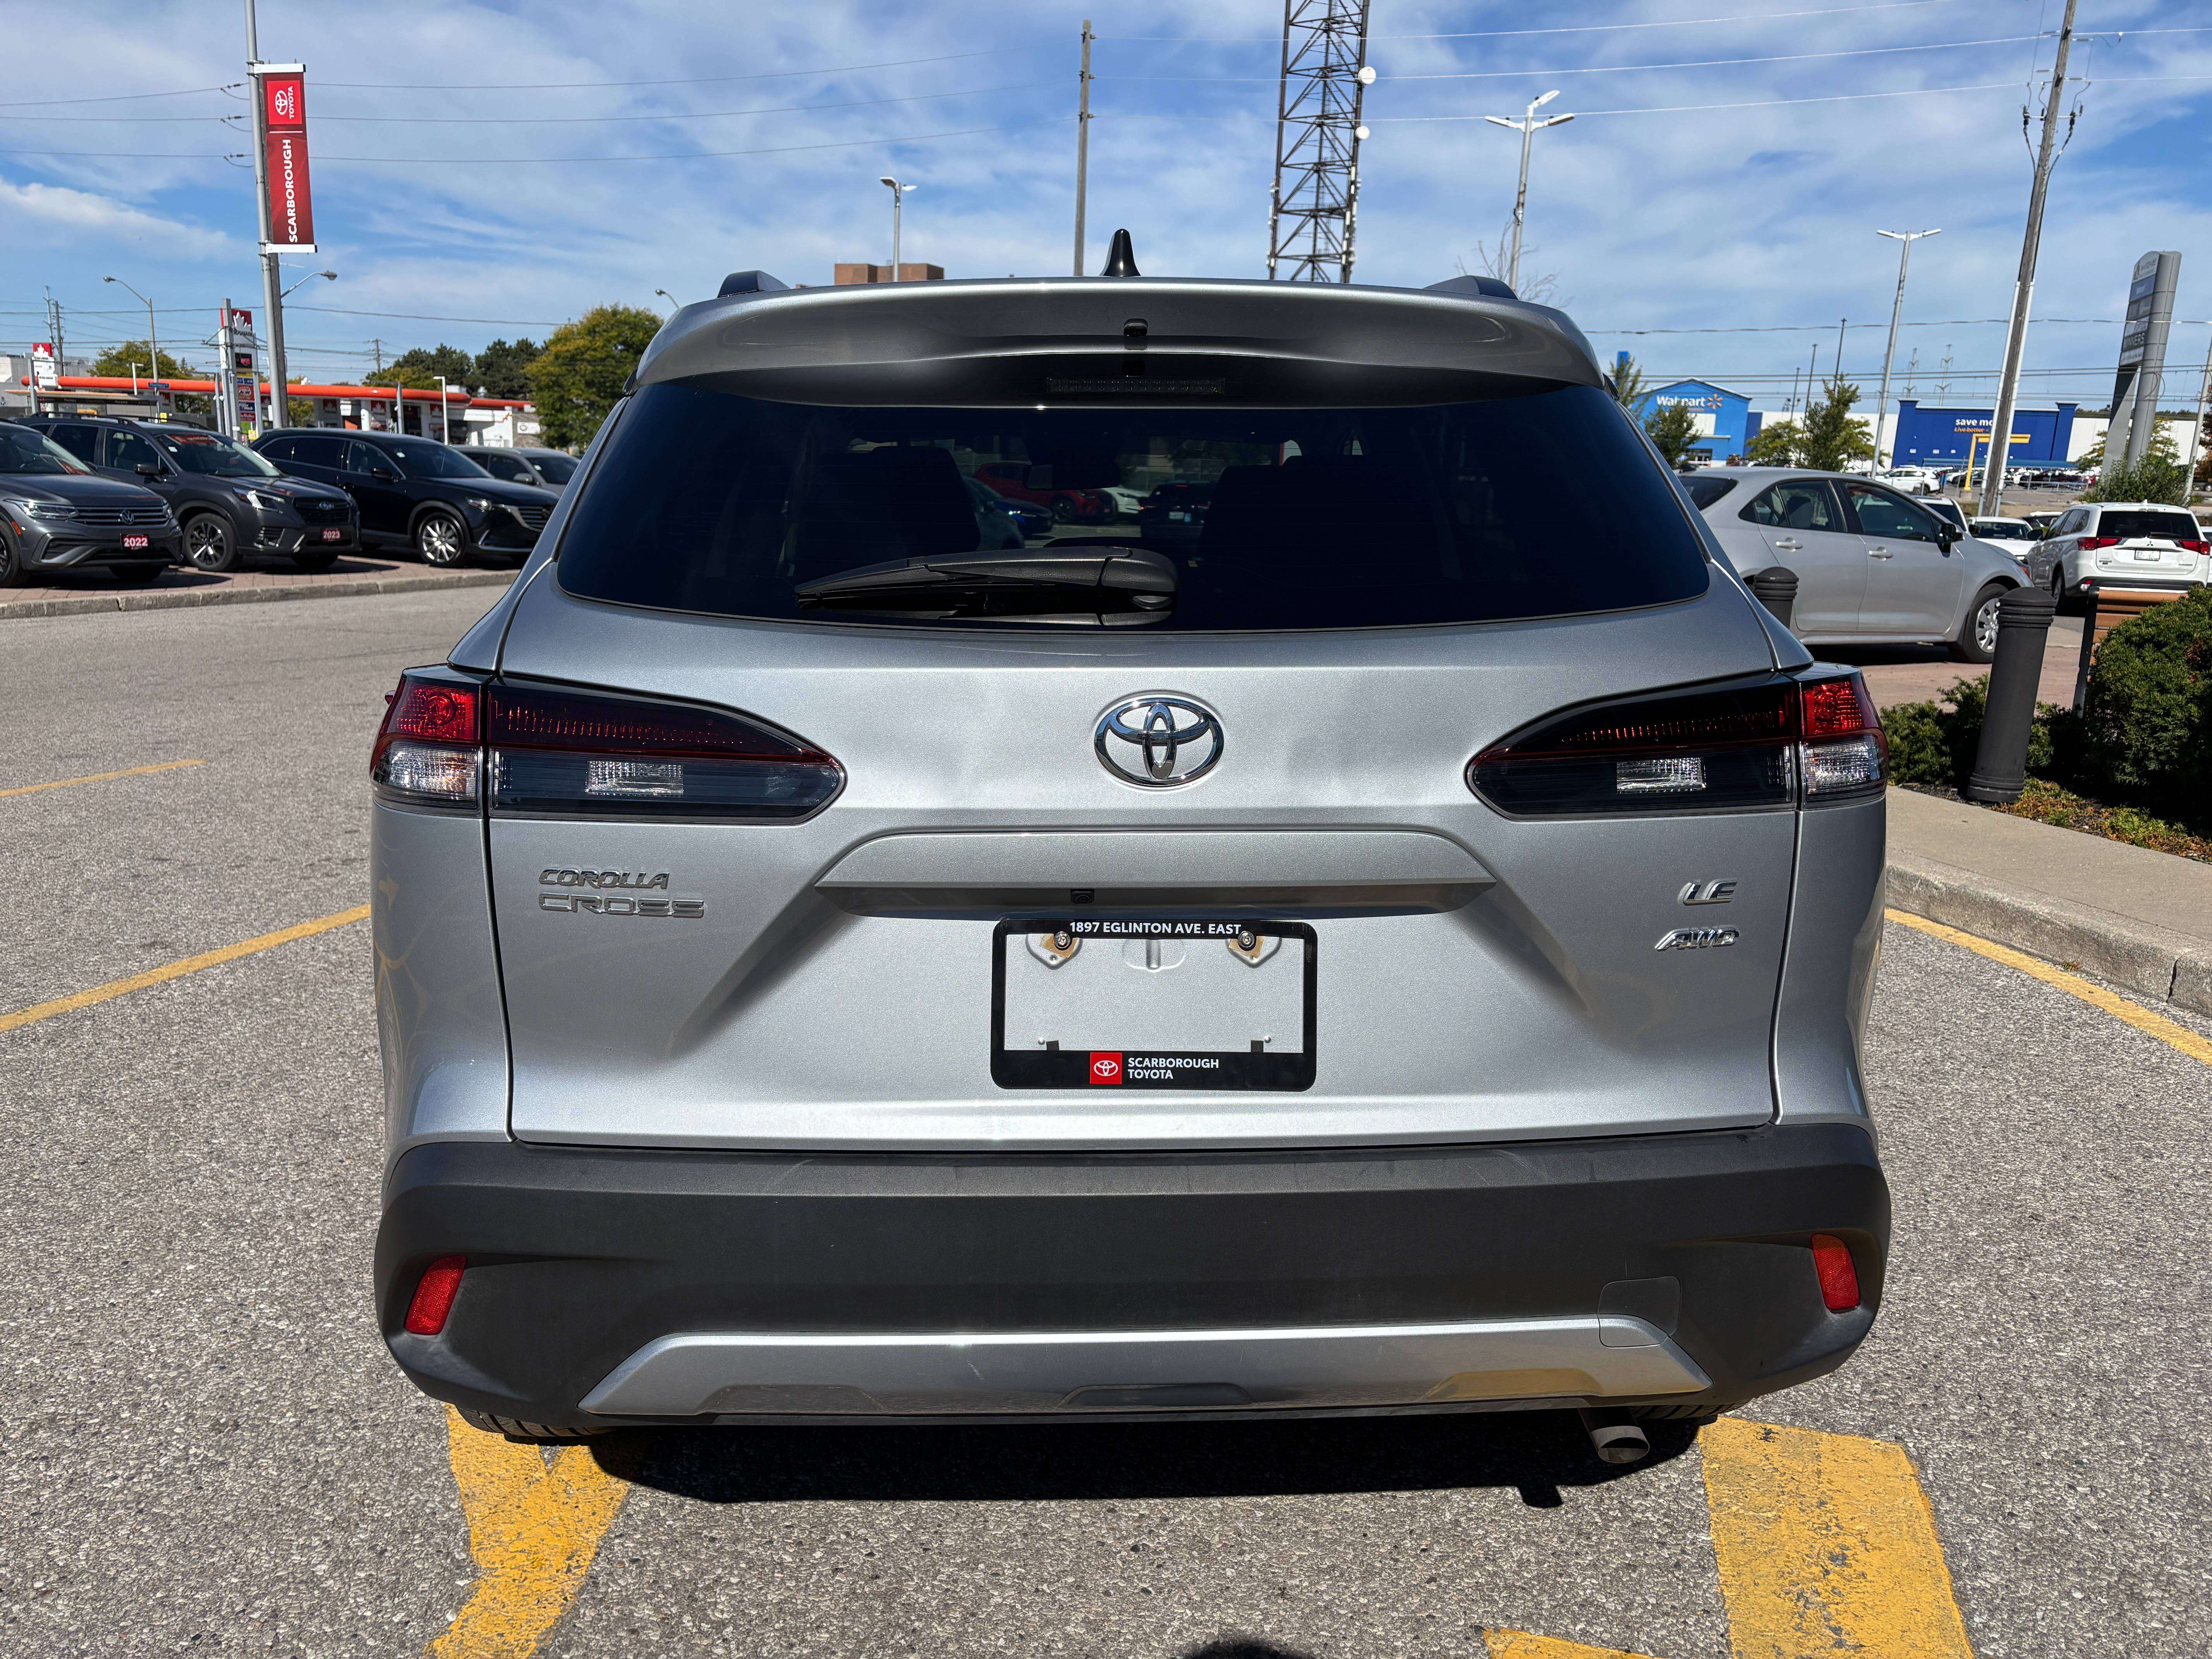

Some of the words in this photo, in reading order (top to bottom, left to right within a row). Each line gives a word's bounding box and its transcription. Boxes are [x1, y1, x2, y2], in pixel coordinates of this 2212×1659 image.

[282, 139, 298, 243] SCARBOROUGH
[1657, 395, 1705, 407] Walmart
[124, 537, 148, 547] 2022
[538, 868, 670, 890] COROLLA
[1683, 879, 1738, 906] LE
[538, 893, 704, 919] CROSS
[1070, 922, 1100, 933] 1897
[1103, 922, 1172, 933] EGLINTON
[1175, 923, 1205, 934] AVE.
[1209, 923, 1241, 935] EAST
[1654, 928, 1740, 951] AWD
[1128, 1058, 1219, 1068] SCARBOROUGH
[1128, 1069, 1174, 1079] TOYOTA
